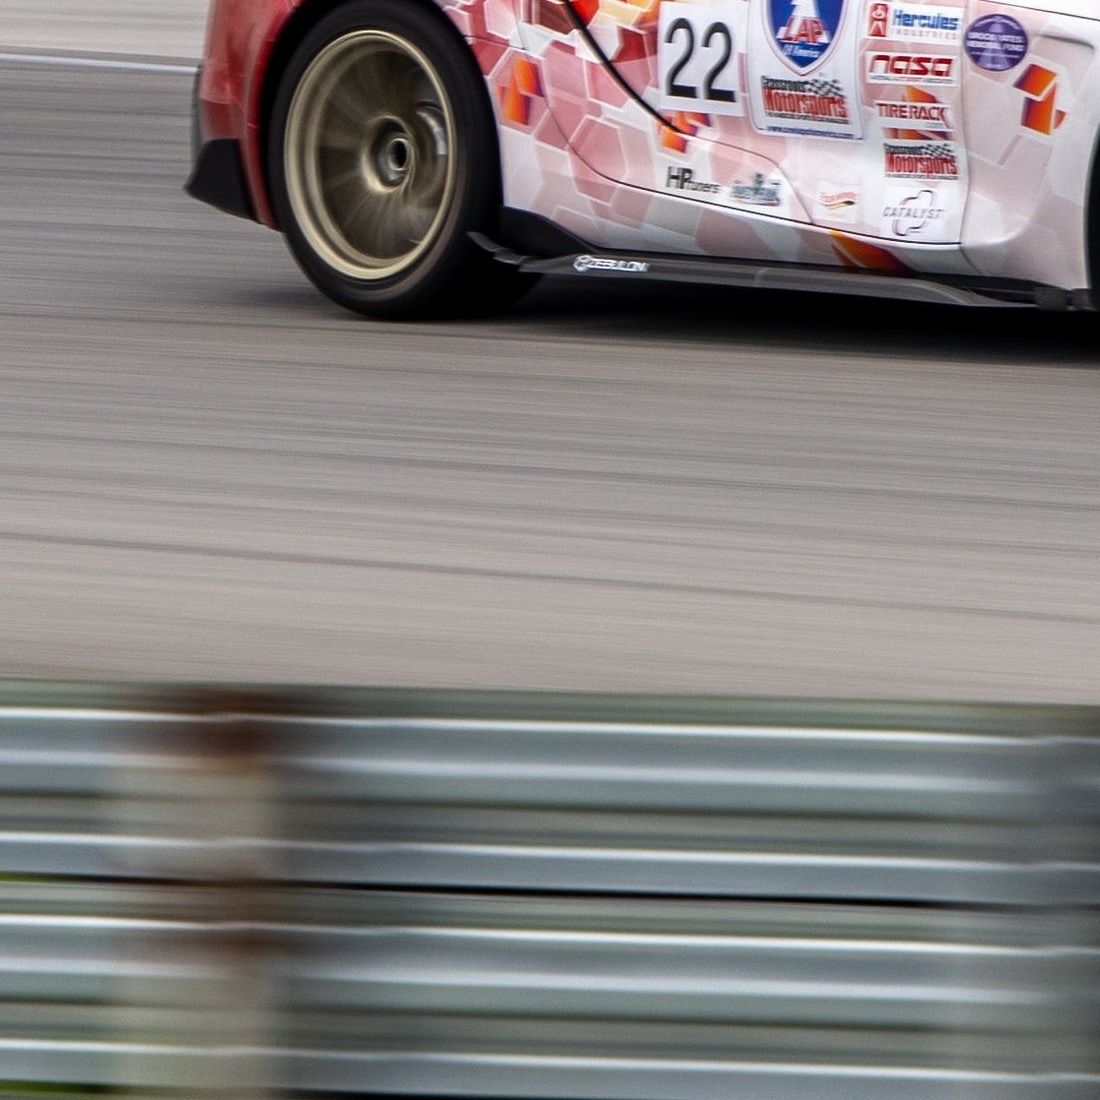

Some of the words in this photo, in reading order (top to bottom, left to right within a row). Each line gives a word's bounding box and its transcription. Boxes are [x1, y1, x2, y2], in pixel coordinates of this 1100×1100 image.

[783, 16, 825, 43] LAP
[893, 9, 959, 31] Hercules
[664, 17, 736, 102] 22
[762, 88, 848, 121] Motorsports
[876, 103, 907, 119] TIRE
[909, 105, 949, 129] RACK
[885, 152, 957, 177] Motorsports
[883, 206, 945, 219] CATALYST
[586, 258, 650, 273] ZEBULON
